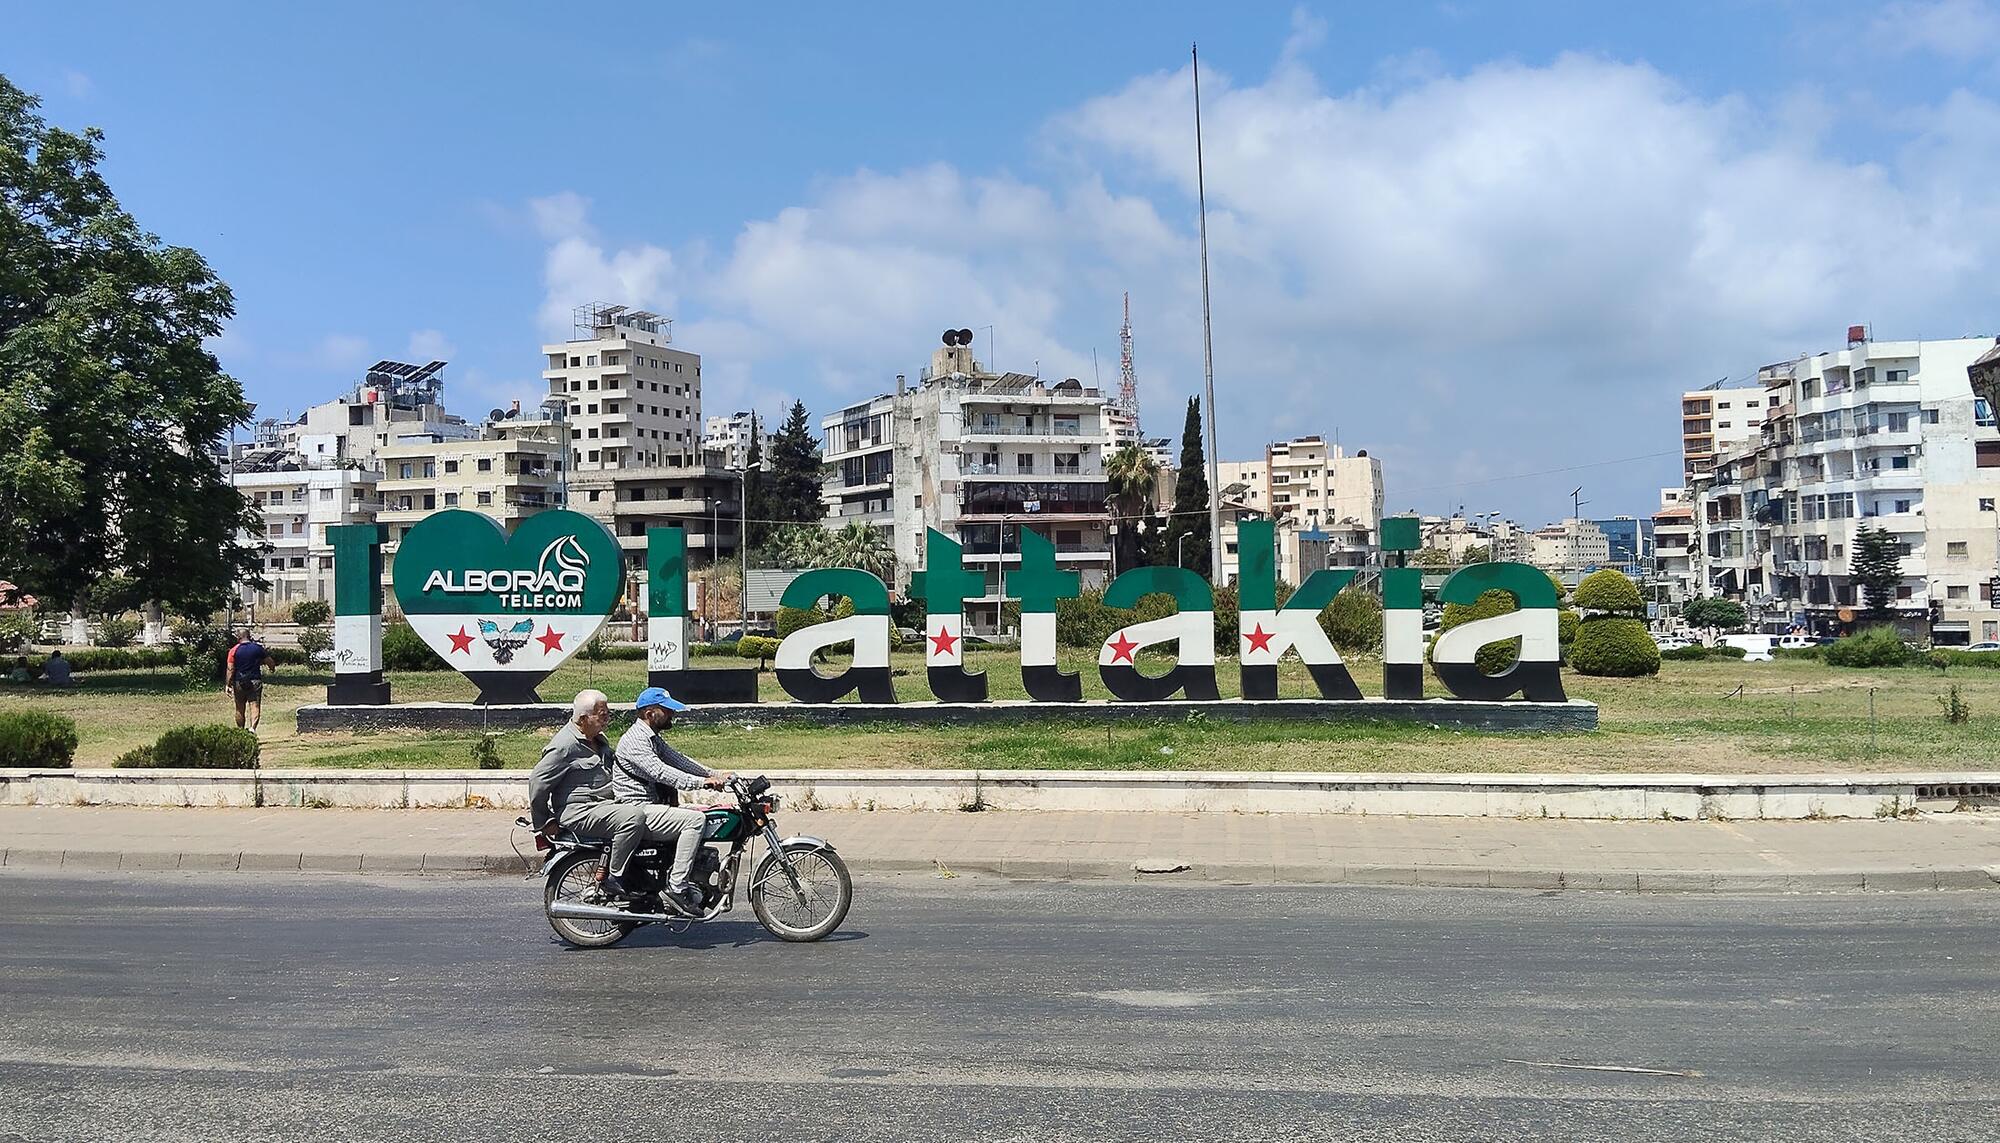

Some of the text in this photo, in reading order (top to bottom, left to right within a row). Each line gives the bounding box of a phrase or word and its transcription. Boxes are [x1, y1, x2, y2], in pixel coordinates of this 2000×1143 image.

[422, 570, 584, 592] ALBORAQ
[325, 517, 1568, 706] I Lattakia
[499, 594, 582, 608] TELECOM
